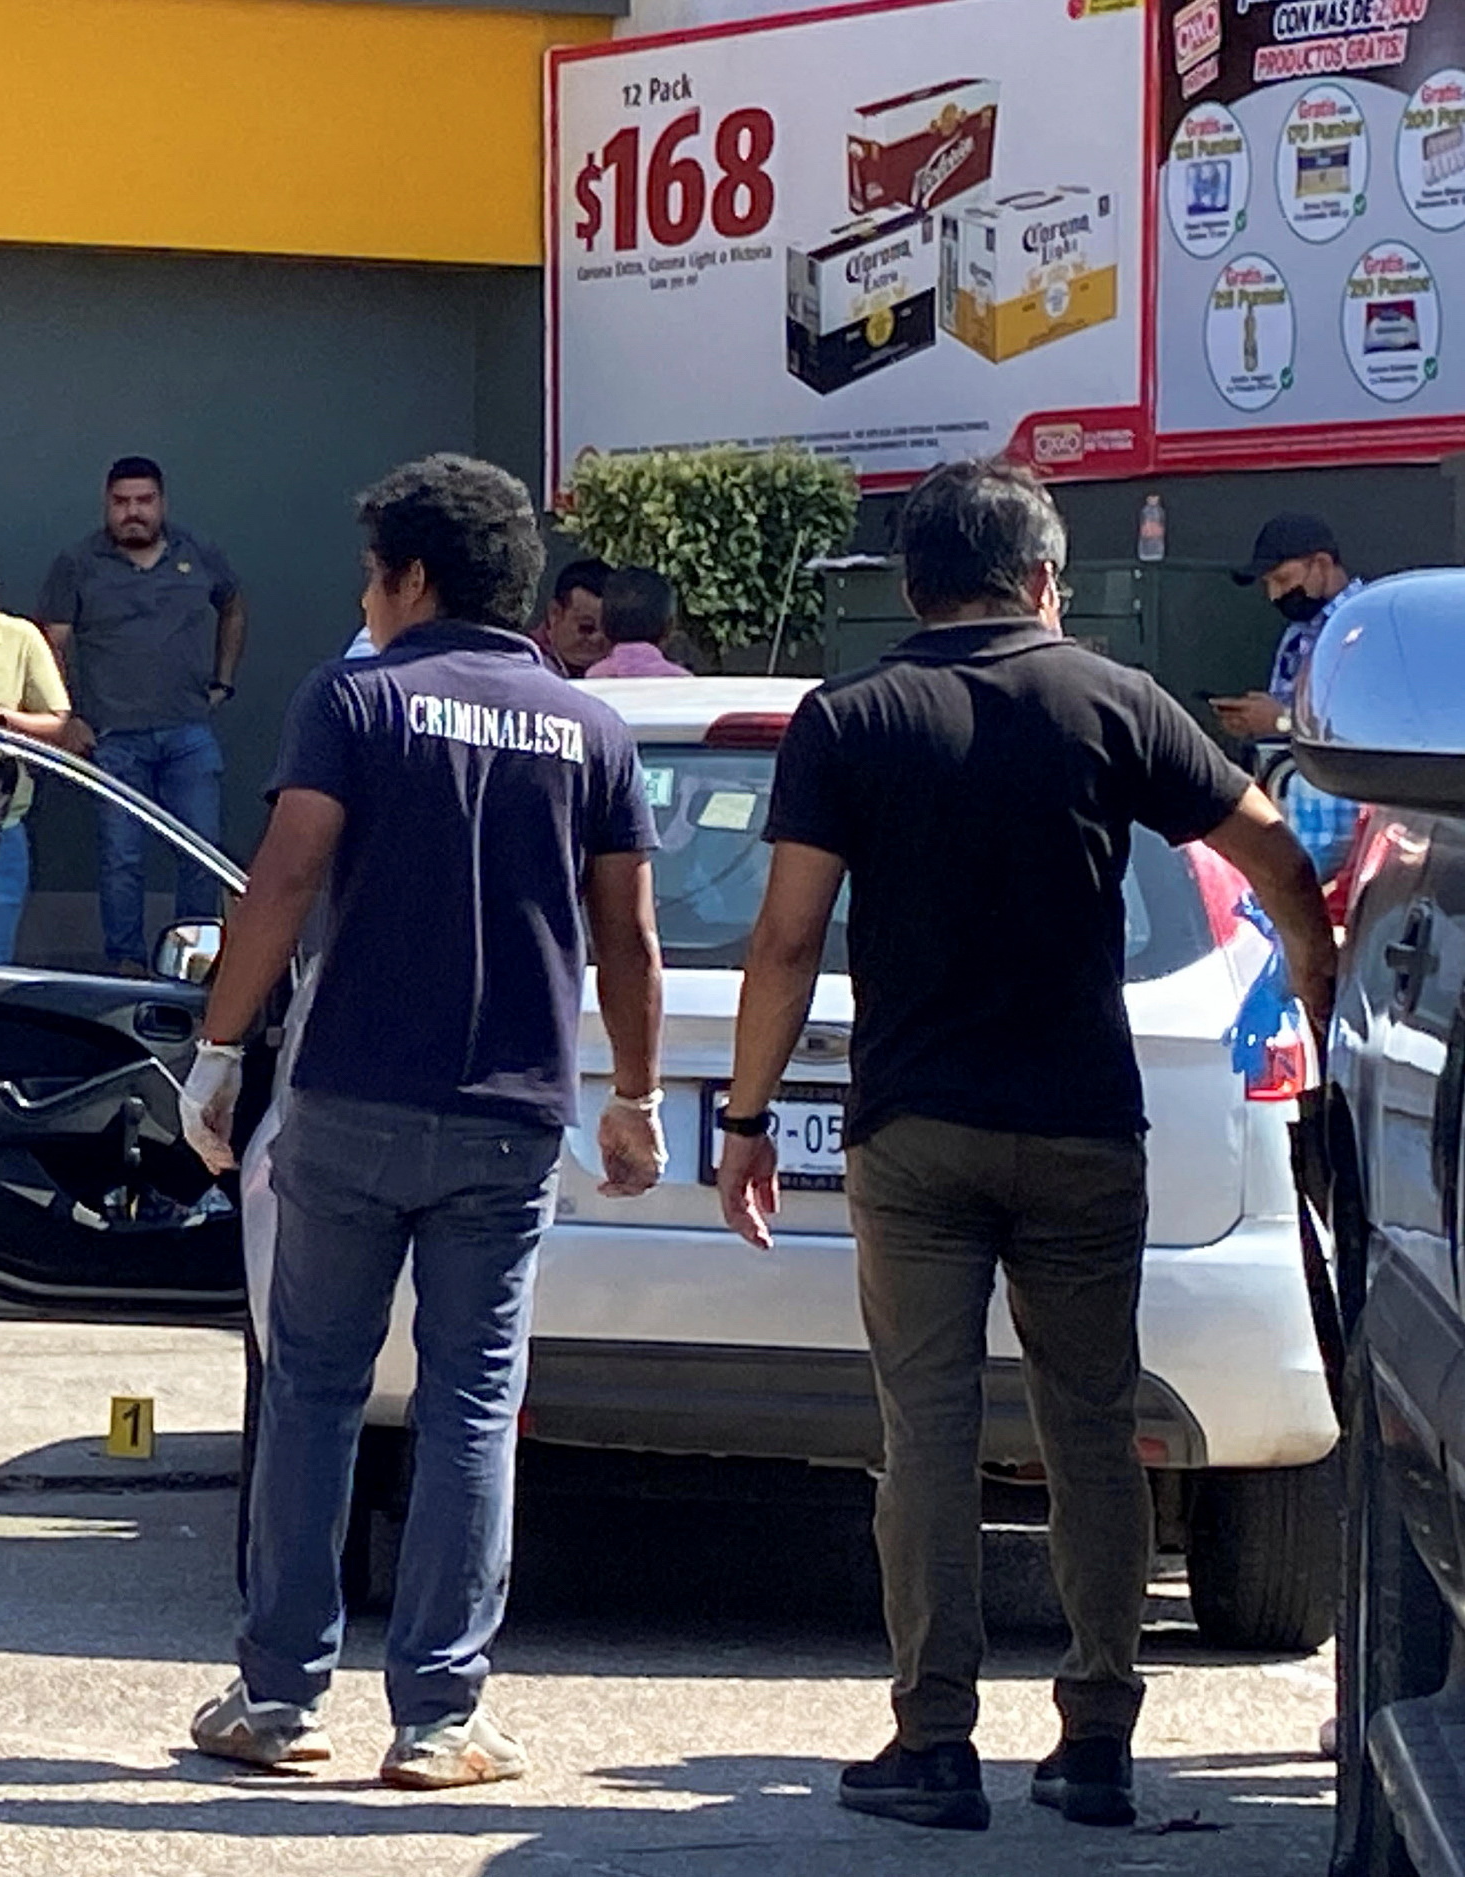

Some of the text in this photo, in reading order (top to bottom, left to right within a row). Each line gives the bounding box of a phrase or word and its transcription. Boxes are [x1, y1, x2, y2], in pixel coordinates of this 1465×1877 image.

[1277, 7, 1310, 36] CON
[1258, 39, 1343, 77] PRODUCTOS
[622, 73, 692, 107] 12 Pack
[575, 106, 775, 251] $168
[1022, 214, 1092, 253] Corona
[846, 240, 913, 284] Corona
[409, 694, 584, 764] CRIMINALISTA
[122, 1402, 141, 1448] 1
